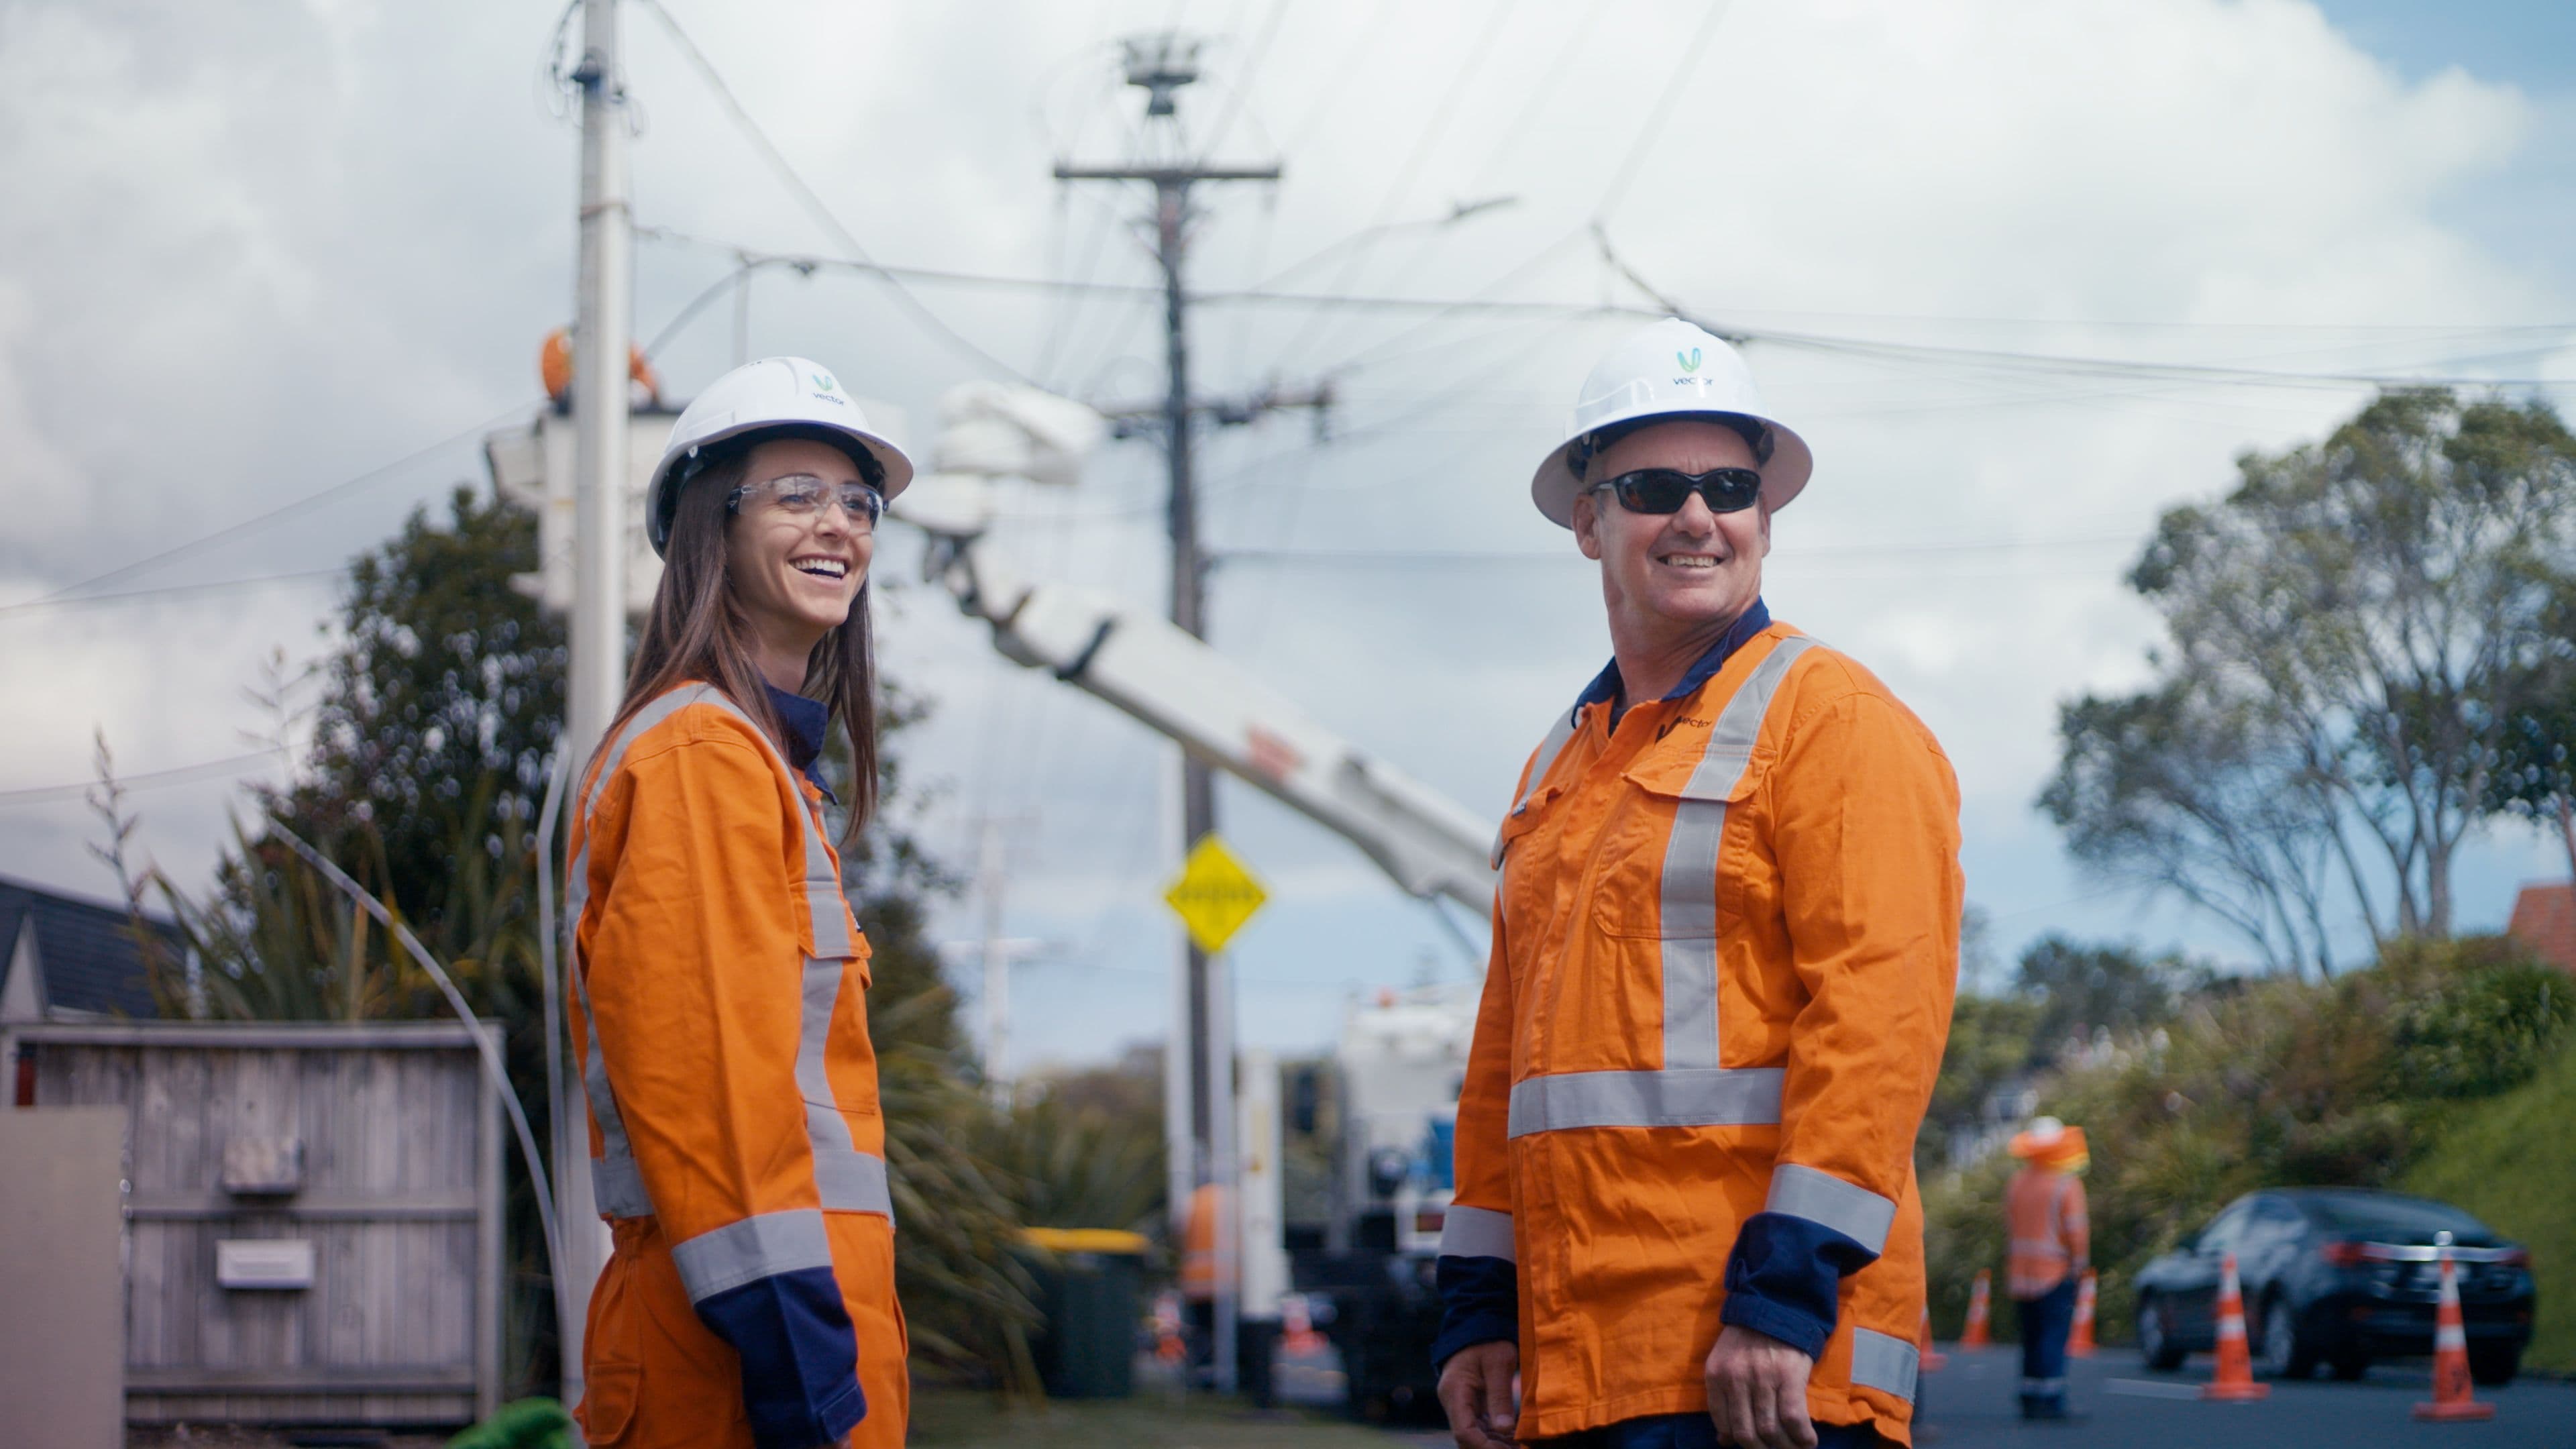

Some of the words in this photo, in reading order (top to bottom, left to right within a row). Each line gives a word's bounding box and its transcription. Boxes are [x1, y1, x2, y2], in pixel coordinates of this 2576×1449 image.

[1673, 376, 1713, 386] vecor
[812, 392, 844, 406] vector
[1682, 716, 1713, 729] ector
